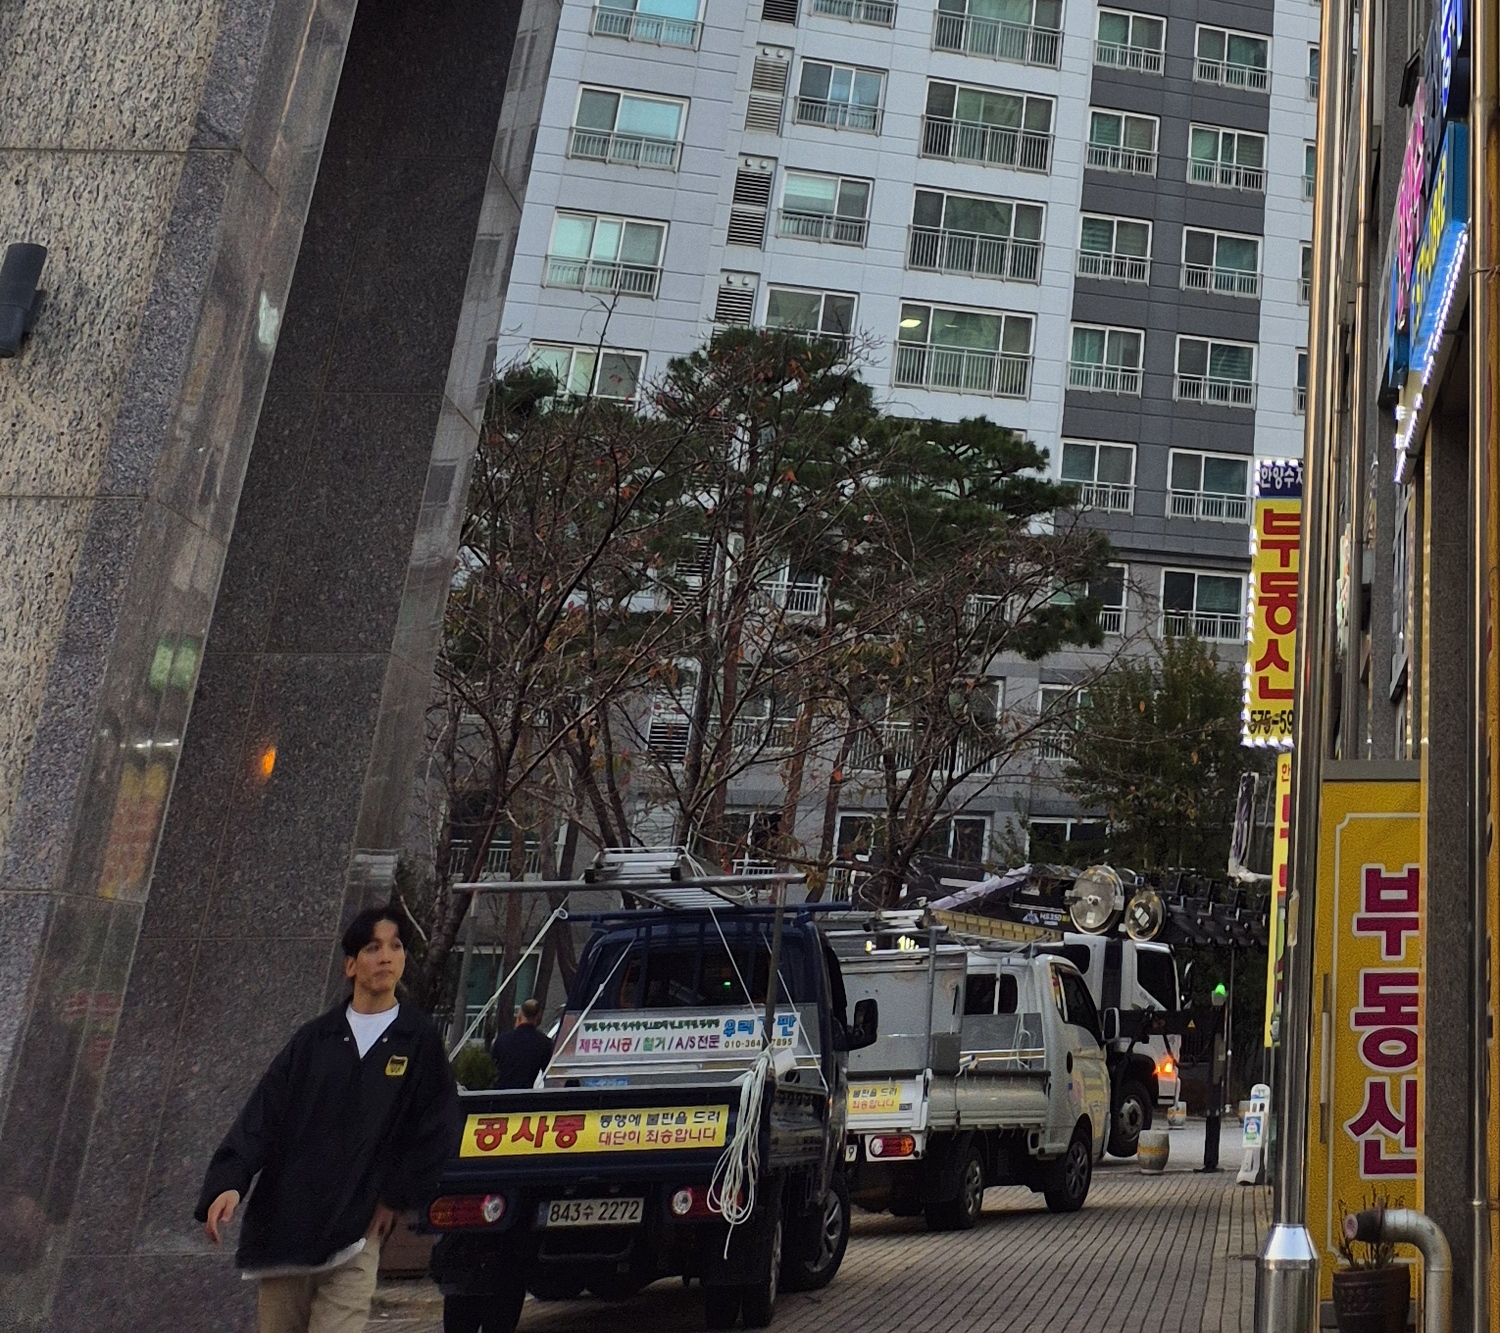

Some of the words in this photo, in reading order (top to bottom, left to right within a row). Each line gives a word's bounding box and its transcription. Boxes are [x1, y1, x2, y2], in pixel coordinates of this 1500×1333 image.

[474, 1114, 586, 1151] 공사중
[645, 1127, 718, 1144] 죄송합니다
[598, 1201, 640, 1221] 2272
